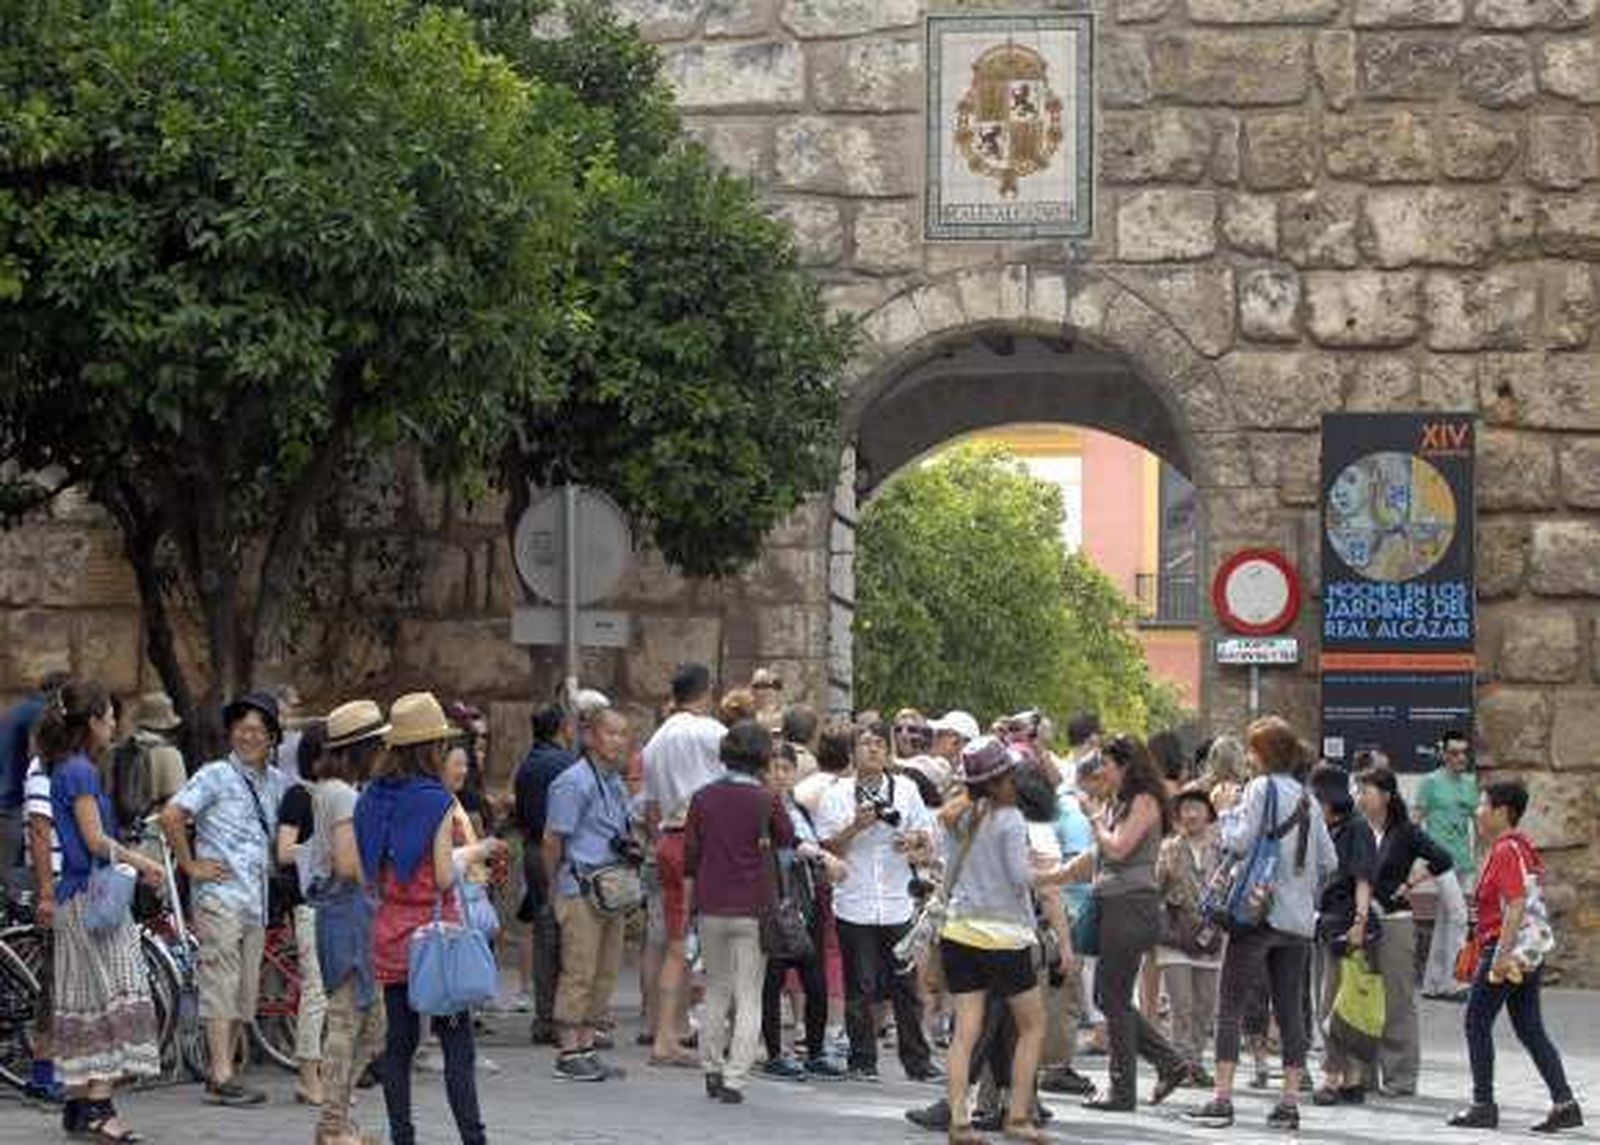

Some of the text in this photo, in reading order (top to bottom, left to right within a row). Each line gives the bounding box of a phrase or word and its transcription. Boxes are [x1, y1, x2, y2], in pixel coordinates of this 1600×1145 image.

[1422, 421, 1469, 448] XIV
[1328, 582, 1467, 598] NOCHES EN LOS
[1325, 599, 1469, 618] JARDINES DEL
[1324, 620, 1369, 638] REAL
